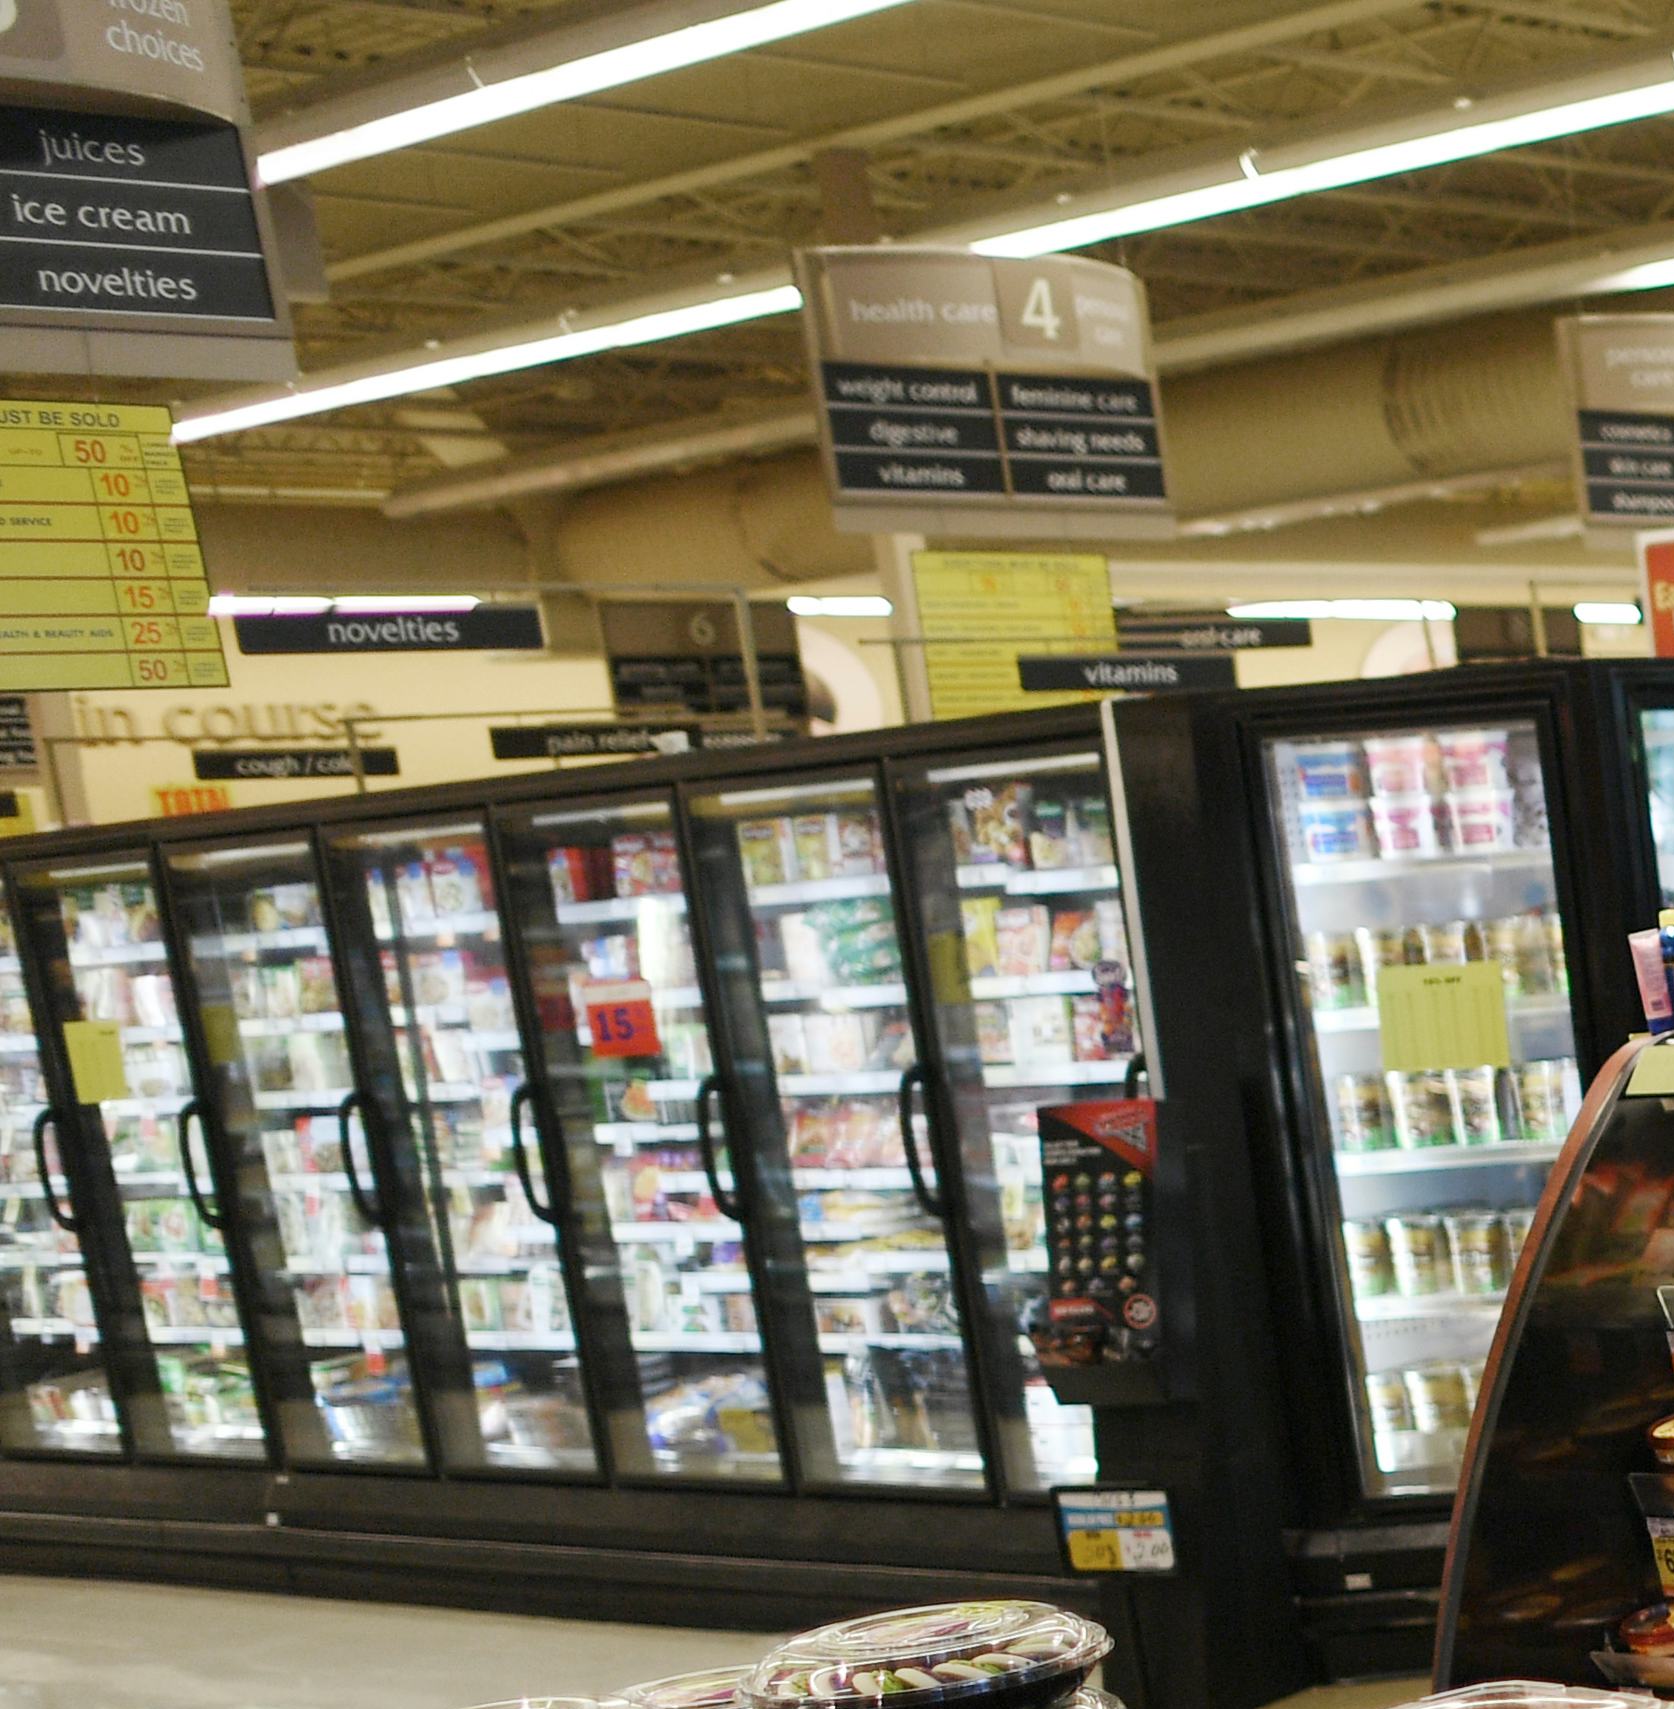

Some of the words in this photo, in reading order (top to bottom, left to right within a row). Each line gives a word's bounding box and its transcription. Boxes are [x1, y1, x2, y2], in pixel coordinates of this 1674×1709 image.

[106, 20, 204, 71] choices
[38, 130, 146, 166] juices
[11, 193, 66, 226] ice
[77, 204, 191, 234] cream
[37, 267, 198, 300] novelties
[1022, 278, 1060, 341] 4
[39, 411, 64, 425] BE
[70, 414, 120, 428] SOLD
[75, 440, 107, 464] 50
[100, 473, 130, 497] 10
[880, 464, 965, 487] vitamins
[110, 511, 139, 535] 10
[117, 548, 145, 572] 10
[125, 586, 155, 609] 15
[131, 621, 162, 645] 25
[328, 614, 460, 646] novelties
[139, 659, 167, 681] 50
[1083, 657, 1178, 683] vitamins
[74, 698, 134, 749] in
[163, 701, 384, 746] course
[236, 757, 299, 779] cough
[597, 1008, 635, 1042] 15
